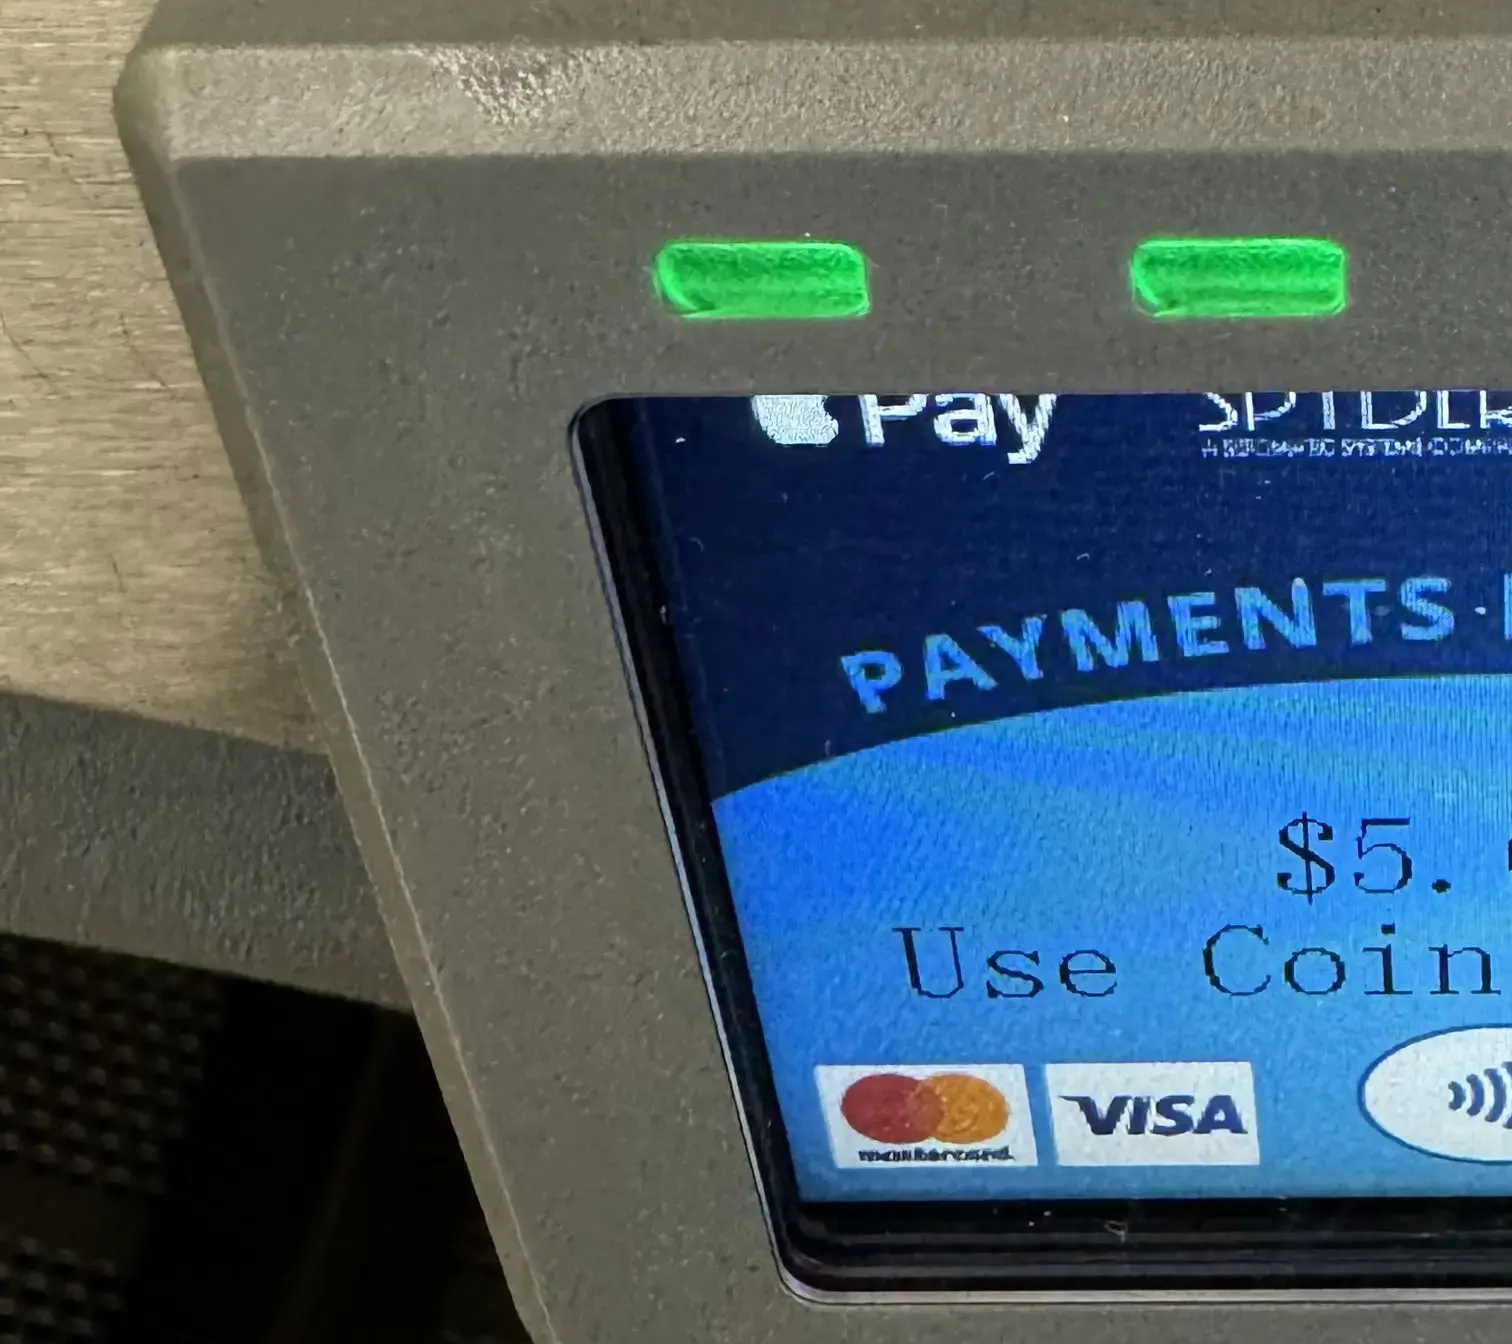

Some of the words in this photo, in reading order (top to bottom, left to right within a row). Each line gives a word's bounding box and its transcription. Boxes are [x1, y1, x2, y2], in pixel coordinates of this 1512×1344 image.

[839, 576, 1457, 714] PAYMENTS
[892, 925, 1118, 999] Use
[1202, 923, 1502, 996] Coin
[1060, 1094, 1249, 1136] VISA
